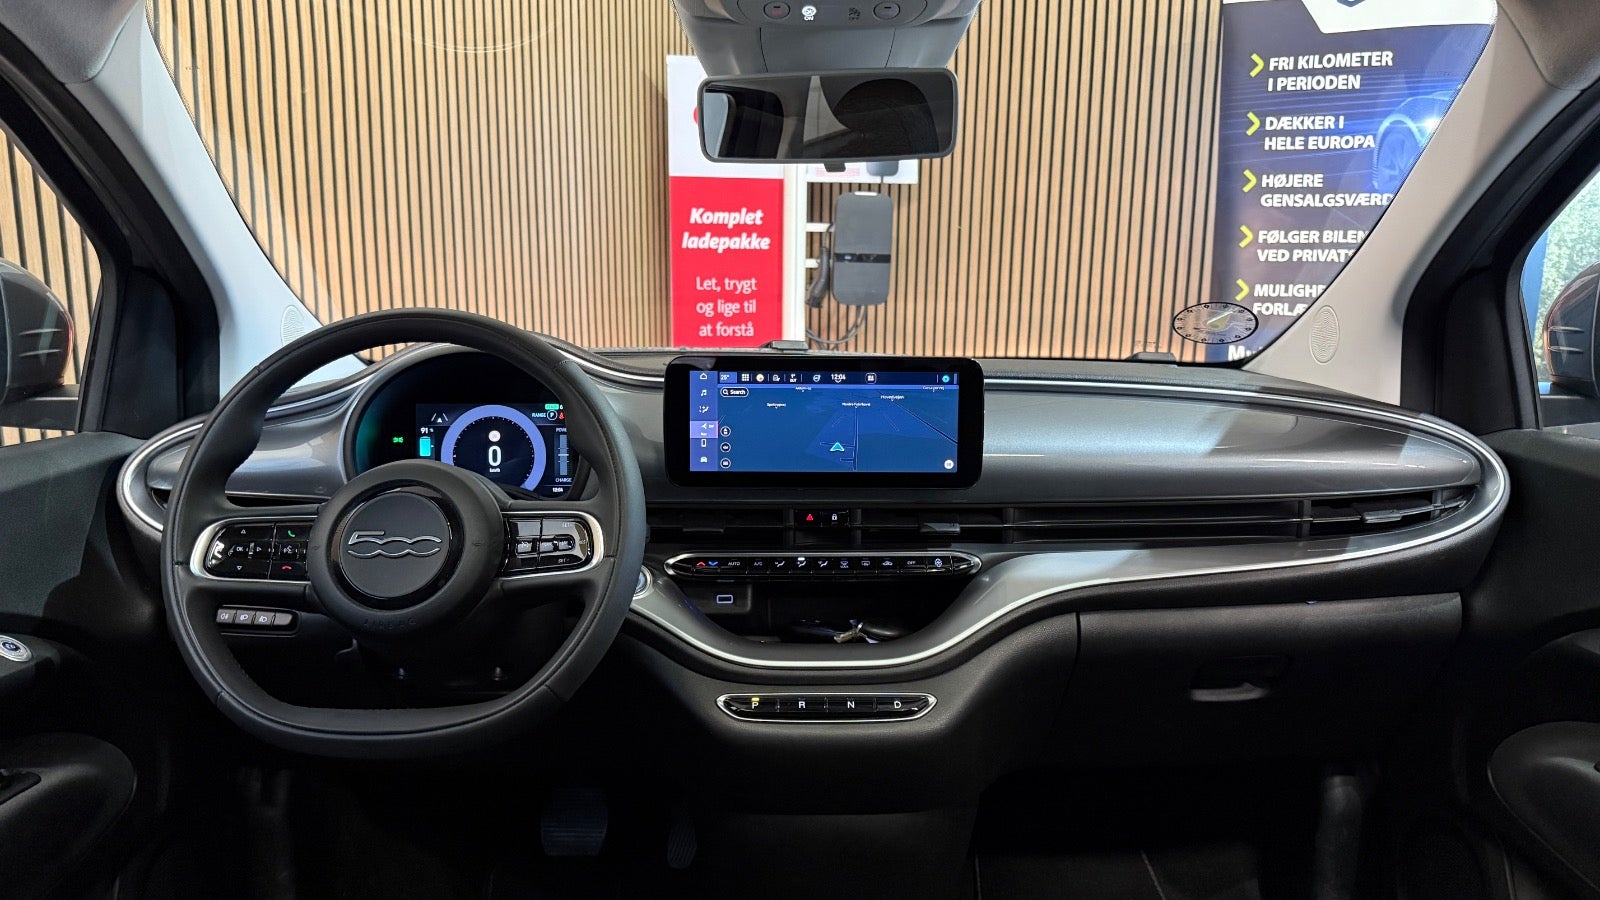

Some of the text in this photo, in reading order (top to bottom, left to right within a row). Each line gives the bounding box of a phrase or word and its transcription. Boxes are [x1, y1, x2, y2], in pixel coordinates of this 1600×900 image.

[1269, 51, 1394, 71] FRI KILOMETER
[1267, 75, 1361, 91] I PERIODEN
[1265, 115, 1345, 131] DÆKKER I
[1264, 135, 1375, 151] HELE EUROPA
[1261, 173, 1324, 188] HØJERE
[689, 207, 764, 229] Komplet
[682, 232, 771, 253] ladepakke
[1257, 230, 1320, 244] FØLGER
[1257, 249, 1290, 262] VED
[696, 277, 757, 294] Let, trygt
[696, 299, 757, 317] og lige til
[699, 320, 754, 337] at forstå
[488, 445, 502, 467] 0
[347, 531, 442, 559] 500
[751, 701, 902, 709] P R N D
